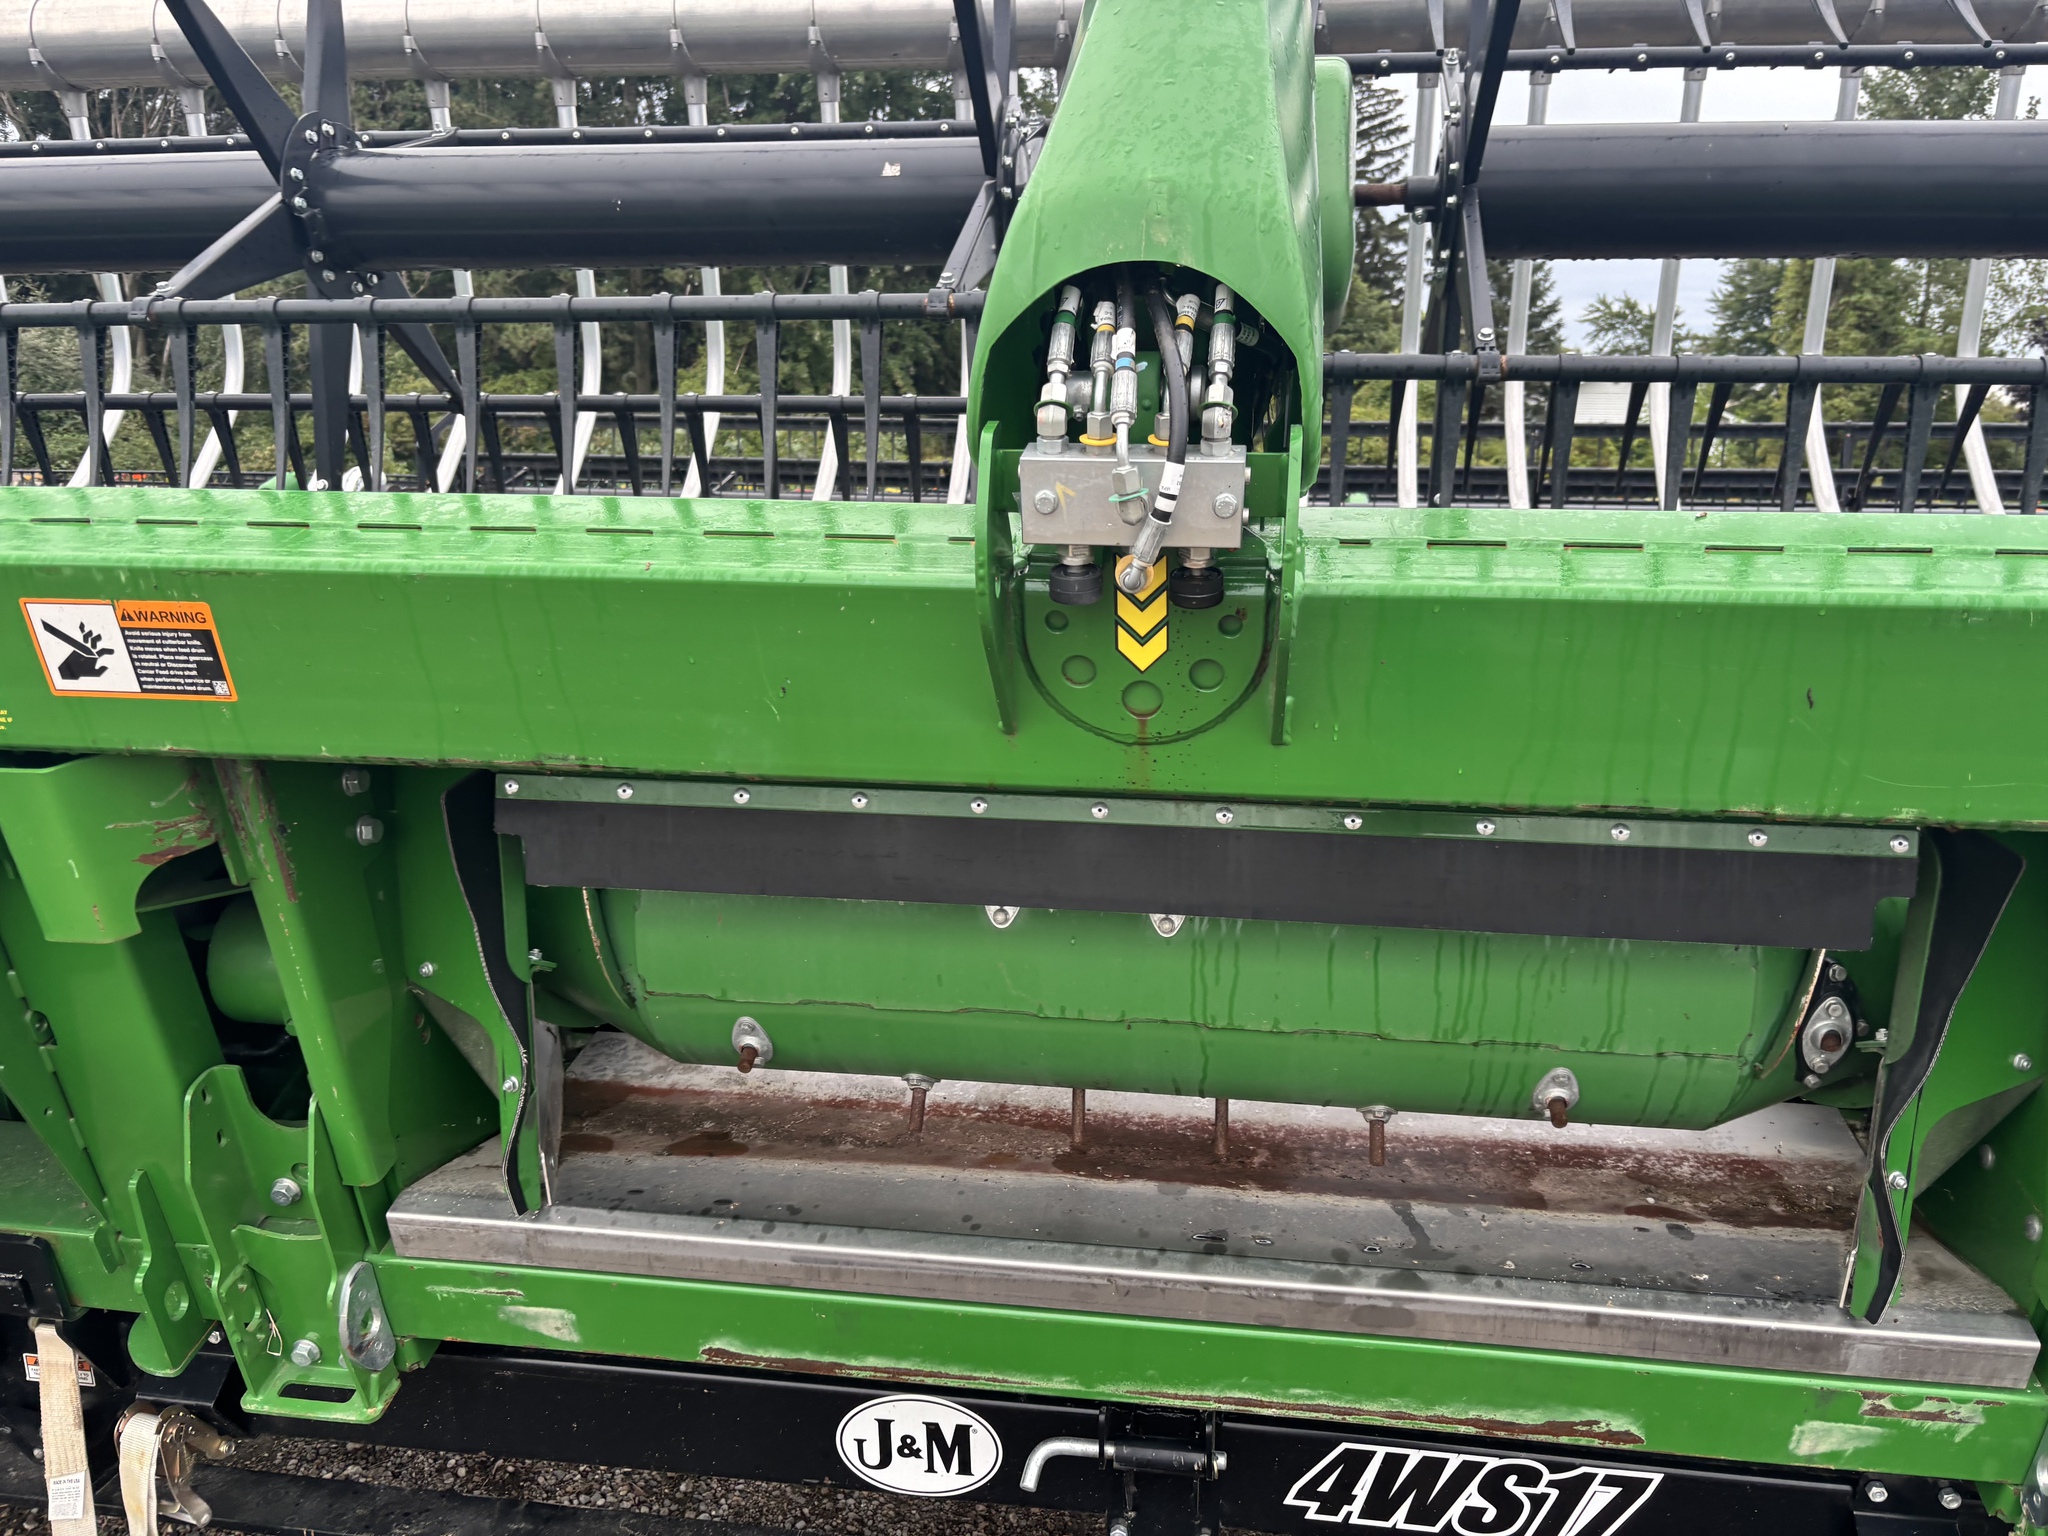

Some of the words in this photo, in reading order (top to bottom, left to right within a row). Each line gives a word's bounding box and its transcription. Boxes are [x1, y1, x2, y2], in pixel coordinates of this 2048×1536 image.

[133, 610, 207, 624] WARNING
[853, 1418, 975, 1476] J&M
[1284, 1442, 1664, 1536] 4WS17
